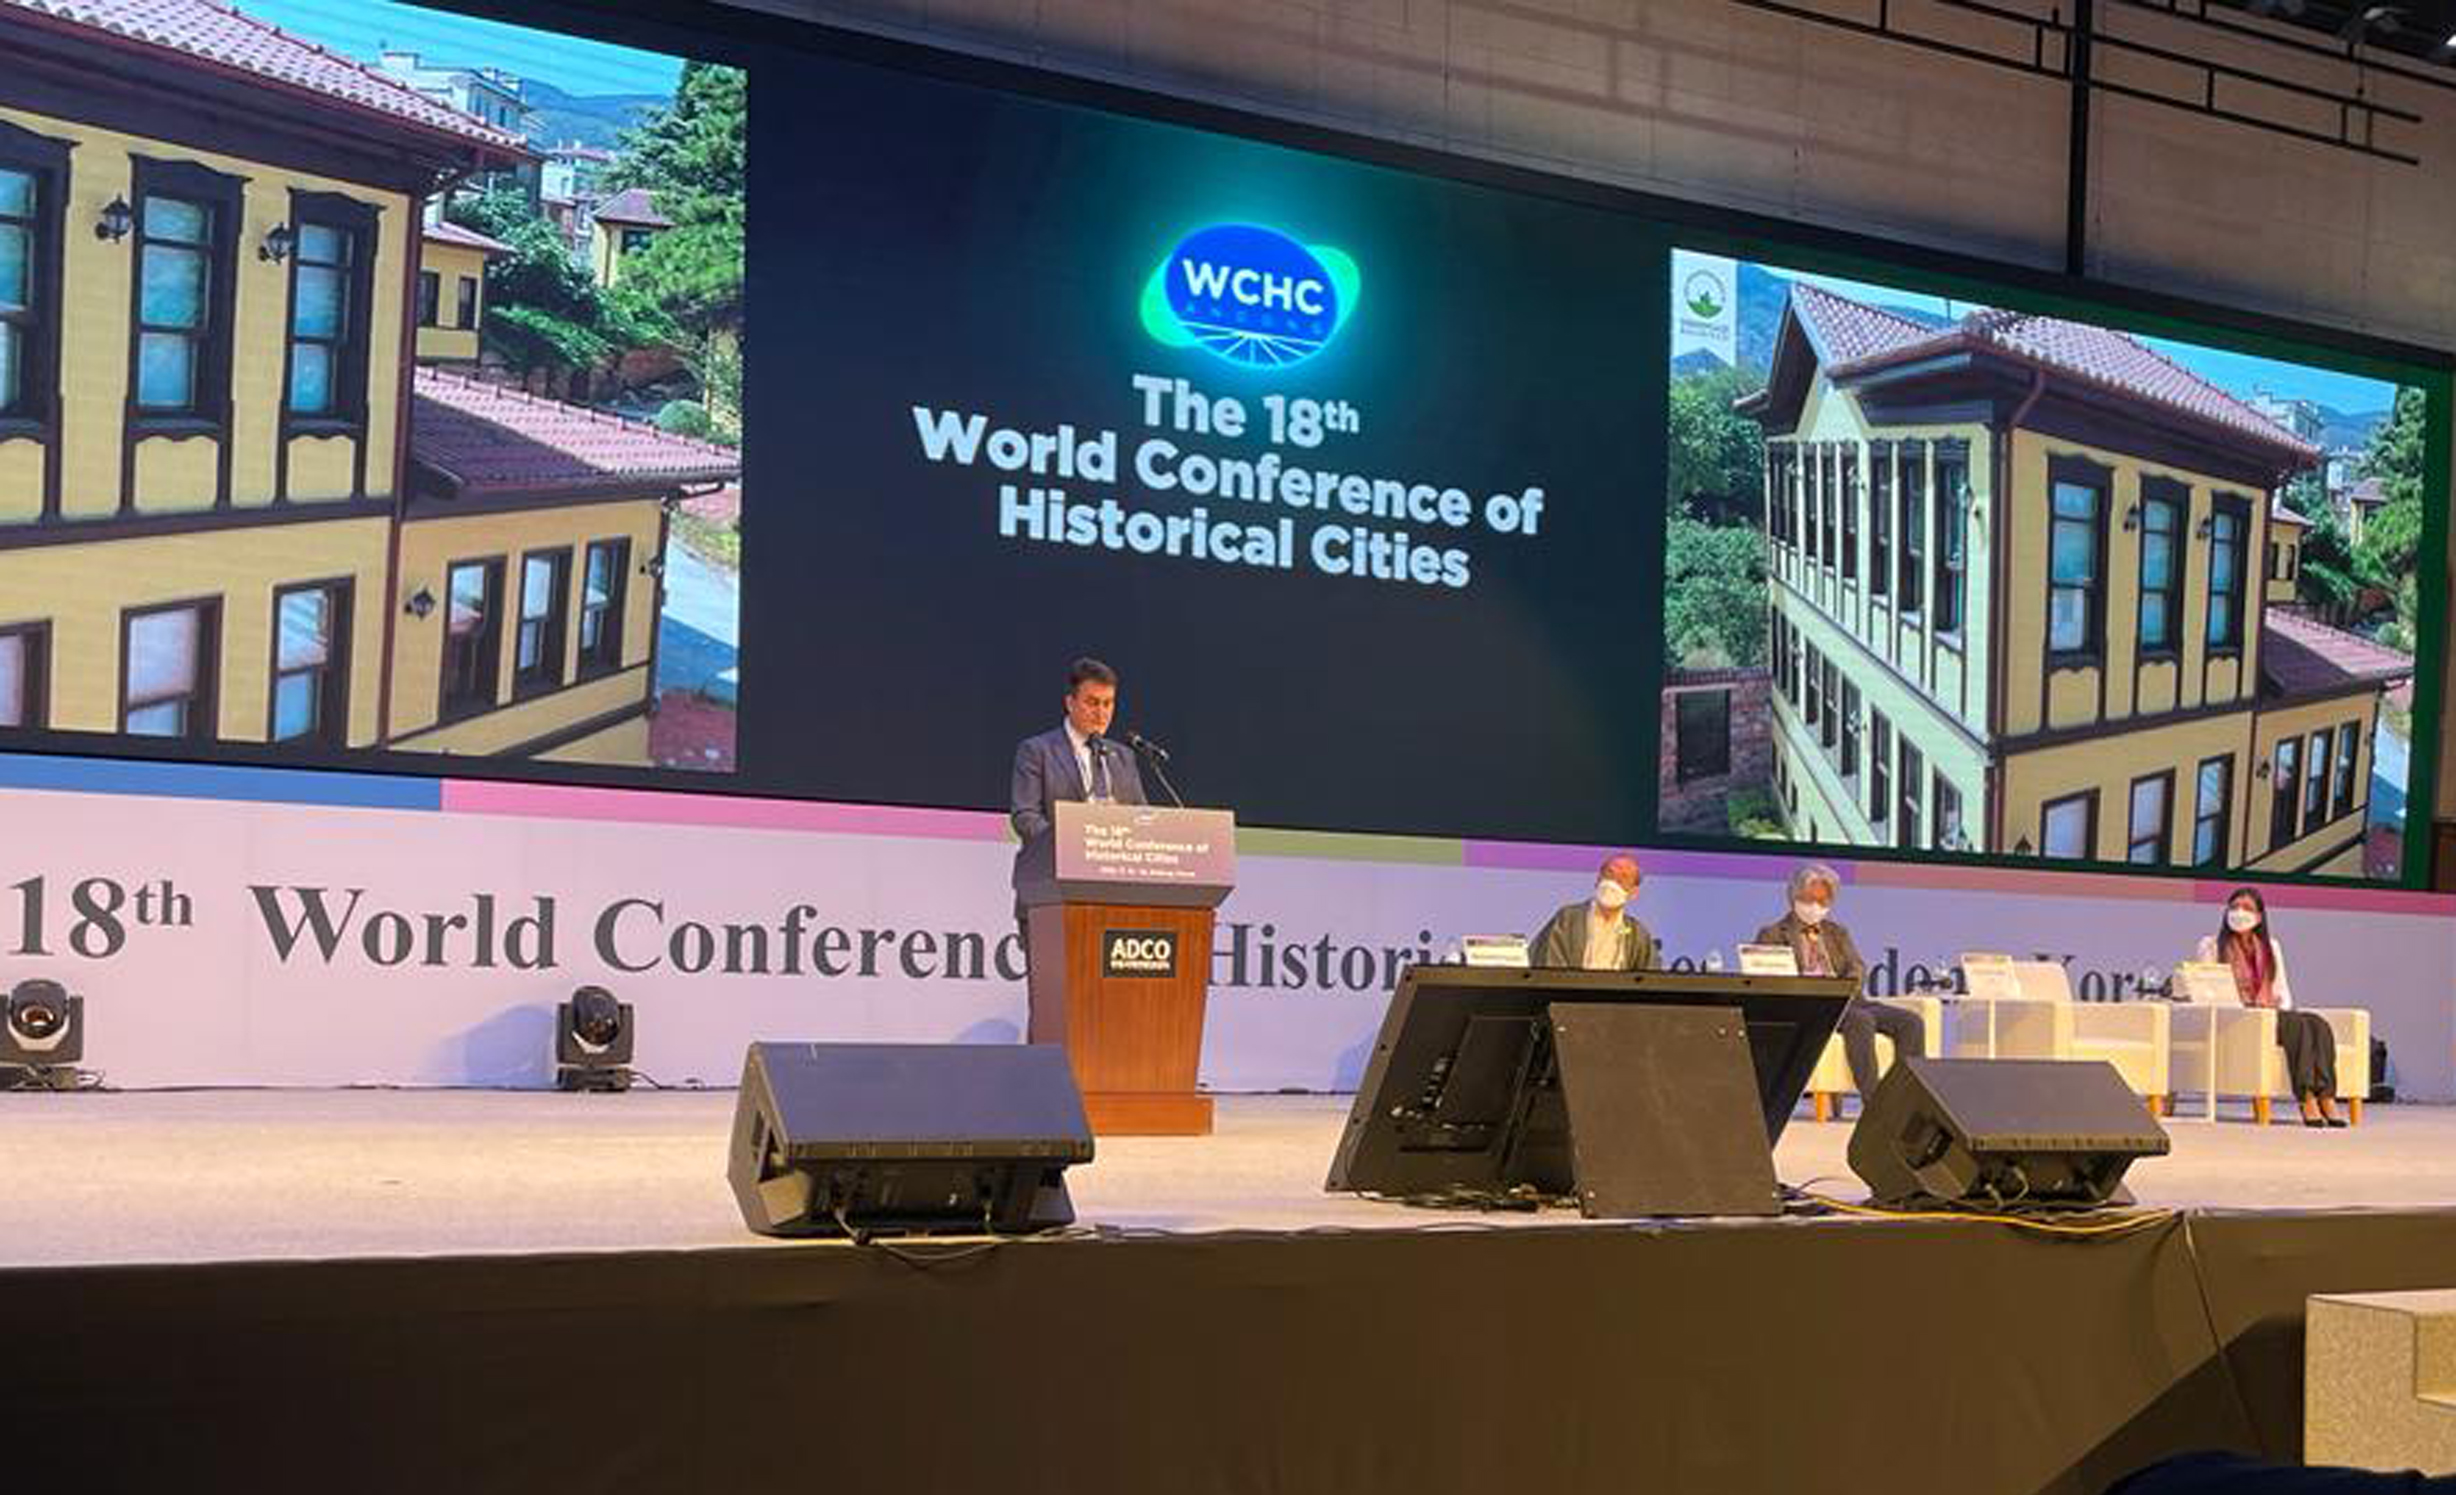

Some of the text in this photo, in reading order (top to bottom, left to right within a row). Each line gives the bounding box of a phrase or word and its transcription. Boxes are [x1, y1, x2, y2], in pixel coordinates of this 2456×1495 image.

[1182, 258, 1324, 315] WCHC
[1133, 373, 1360, 448] The 18th
[911, 405, 1545, 535] World Conference of
[999, 485, 1471, 588] Historical Cities
[7, 875, 193, 959] 18th
[246, 885, 559, 970] World
[593, 897, 1028, 983] Conferenc
[1207, 922, 1434, 993] Histori
[1110, 937, 1172, 961] ADCO
